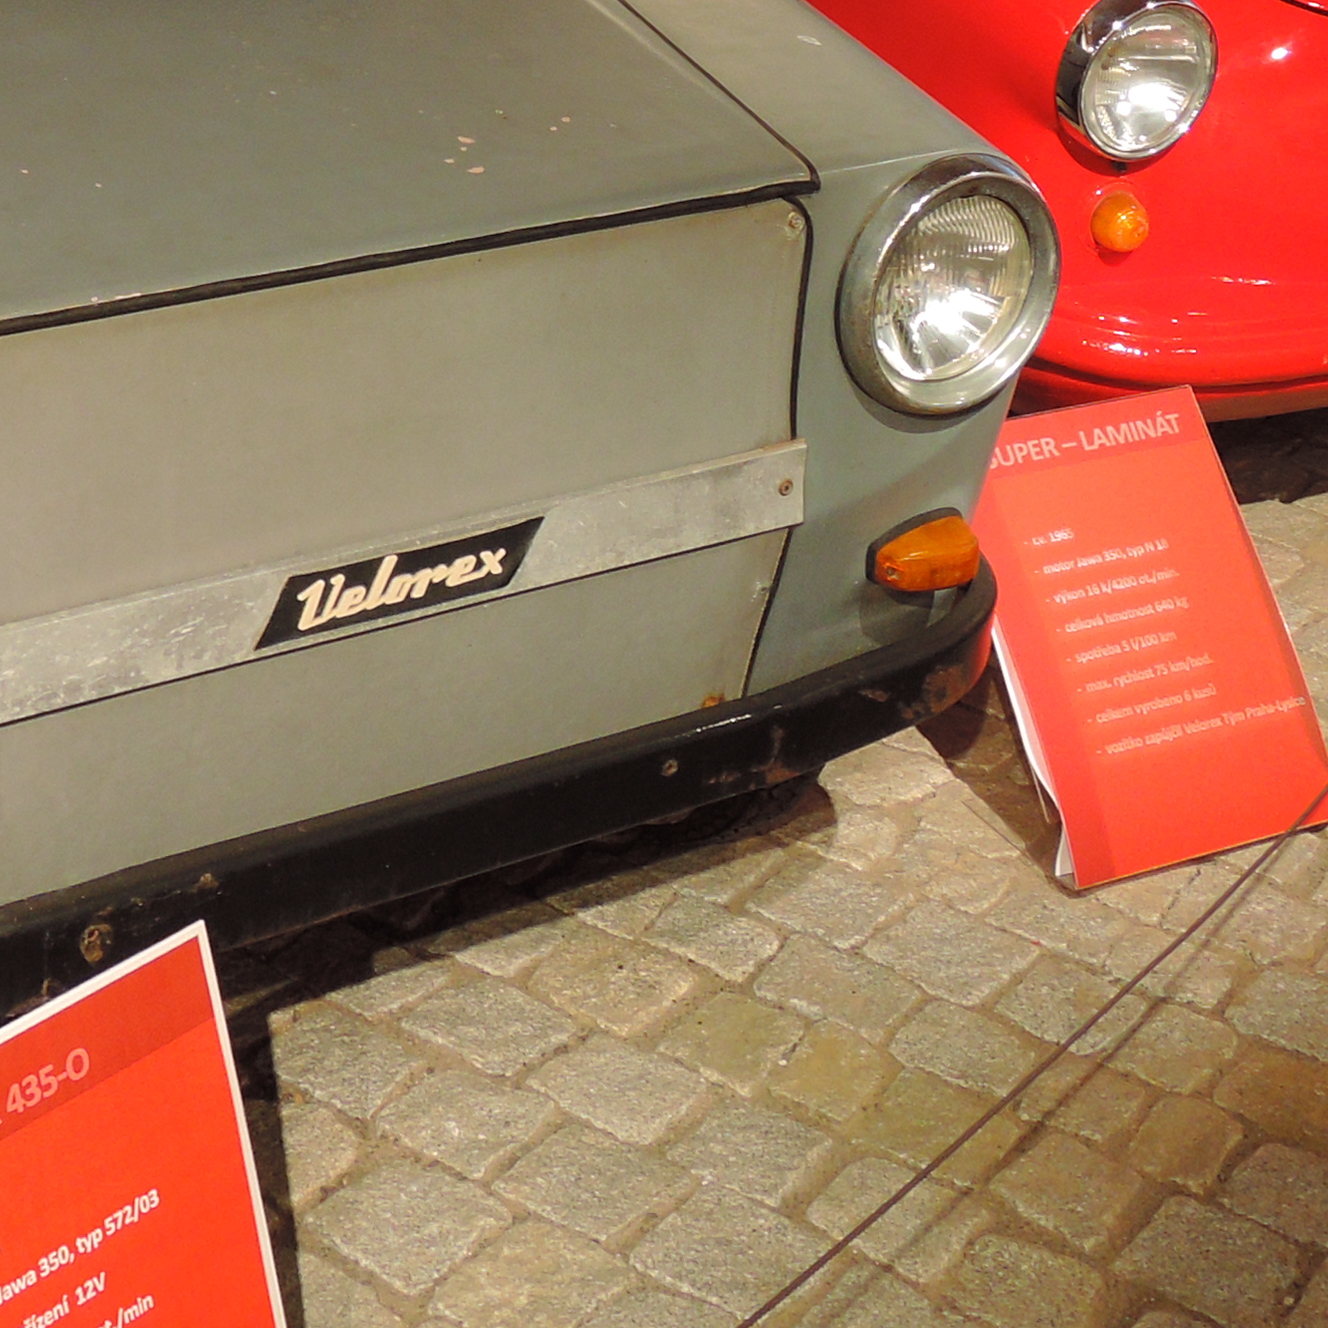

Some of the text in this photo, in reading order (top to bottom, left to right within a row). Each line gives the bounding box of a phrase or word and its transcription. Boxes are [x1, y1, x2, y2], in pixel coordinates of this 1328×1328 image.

[1079, 411, 1179, 451] LAMINÁT
[1043, 560, 1074, 574] motor
[1076, 554, 1103, 568] Jawa
[297, 548, 506, 631] Velorex
[37, 1246, 75, 1278] 350,
[75, 1227, 103, 1254] typ
[103, 1188, 160, 1236] 572/03
[74, 1272, 106, 1306] 12V
